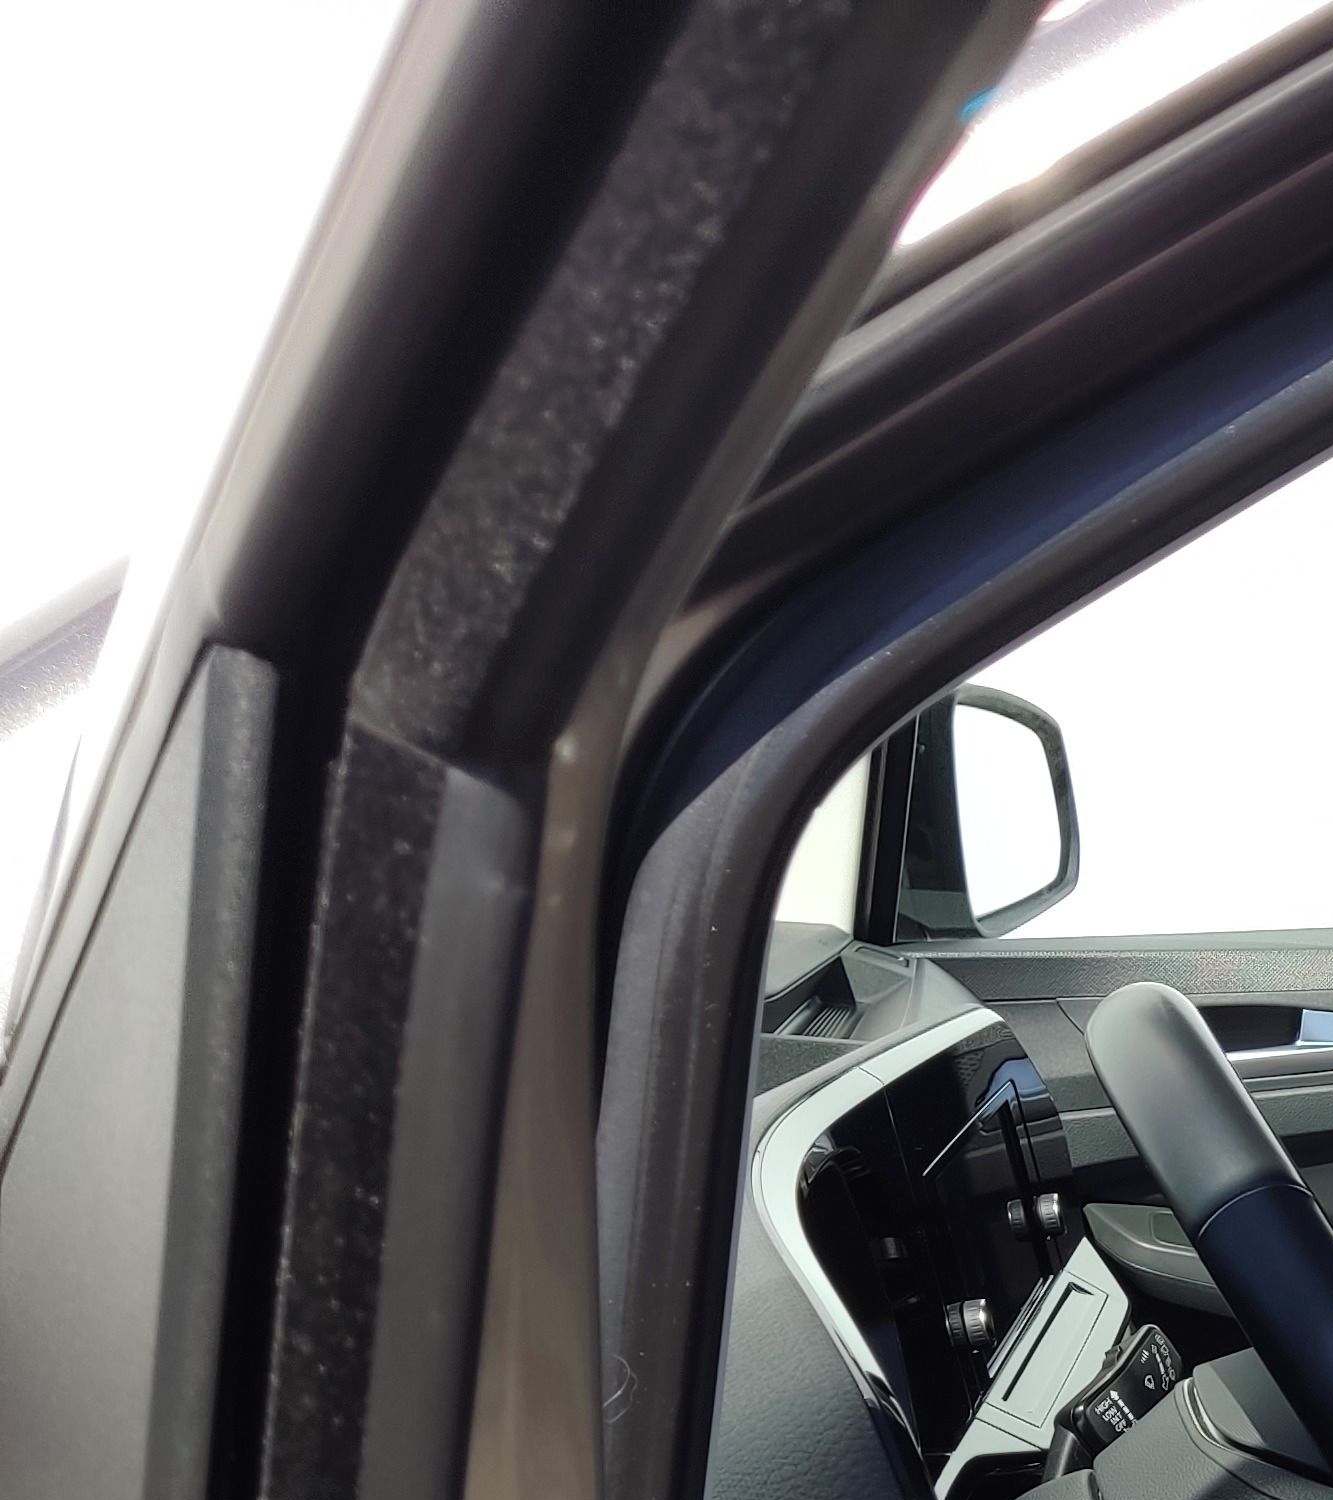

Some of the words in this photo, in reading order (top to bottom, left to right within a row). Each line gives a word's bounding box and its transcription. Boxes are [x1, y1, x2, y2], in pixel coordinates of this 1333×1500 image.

[1094, 1397, 1113, 1415] HIGH
[1102, 1405, 1118, 1421] LOW
[1110, 1411, 1123, 1425] INT
